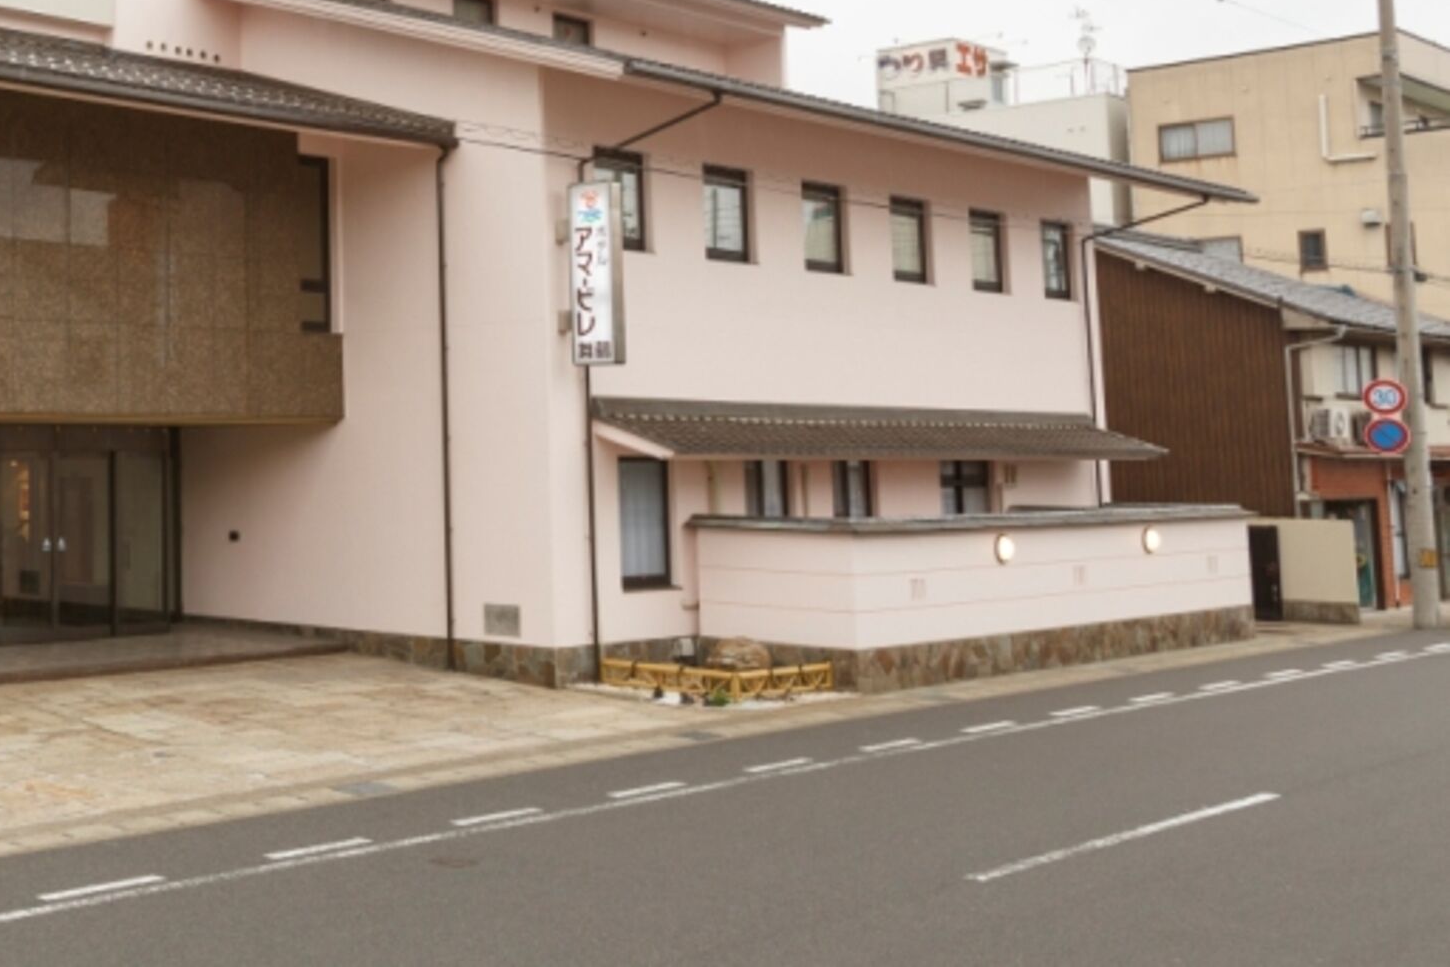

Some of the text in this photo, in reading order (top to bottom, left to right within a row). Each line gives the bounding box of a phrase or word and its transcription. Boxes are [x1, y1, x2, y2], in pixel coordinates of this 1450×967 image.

[575, 227, 595, 337] アマービレ
